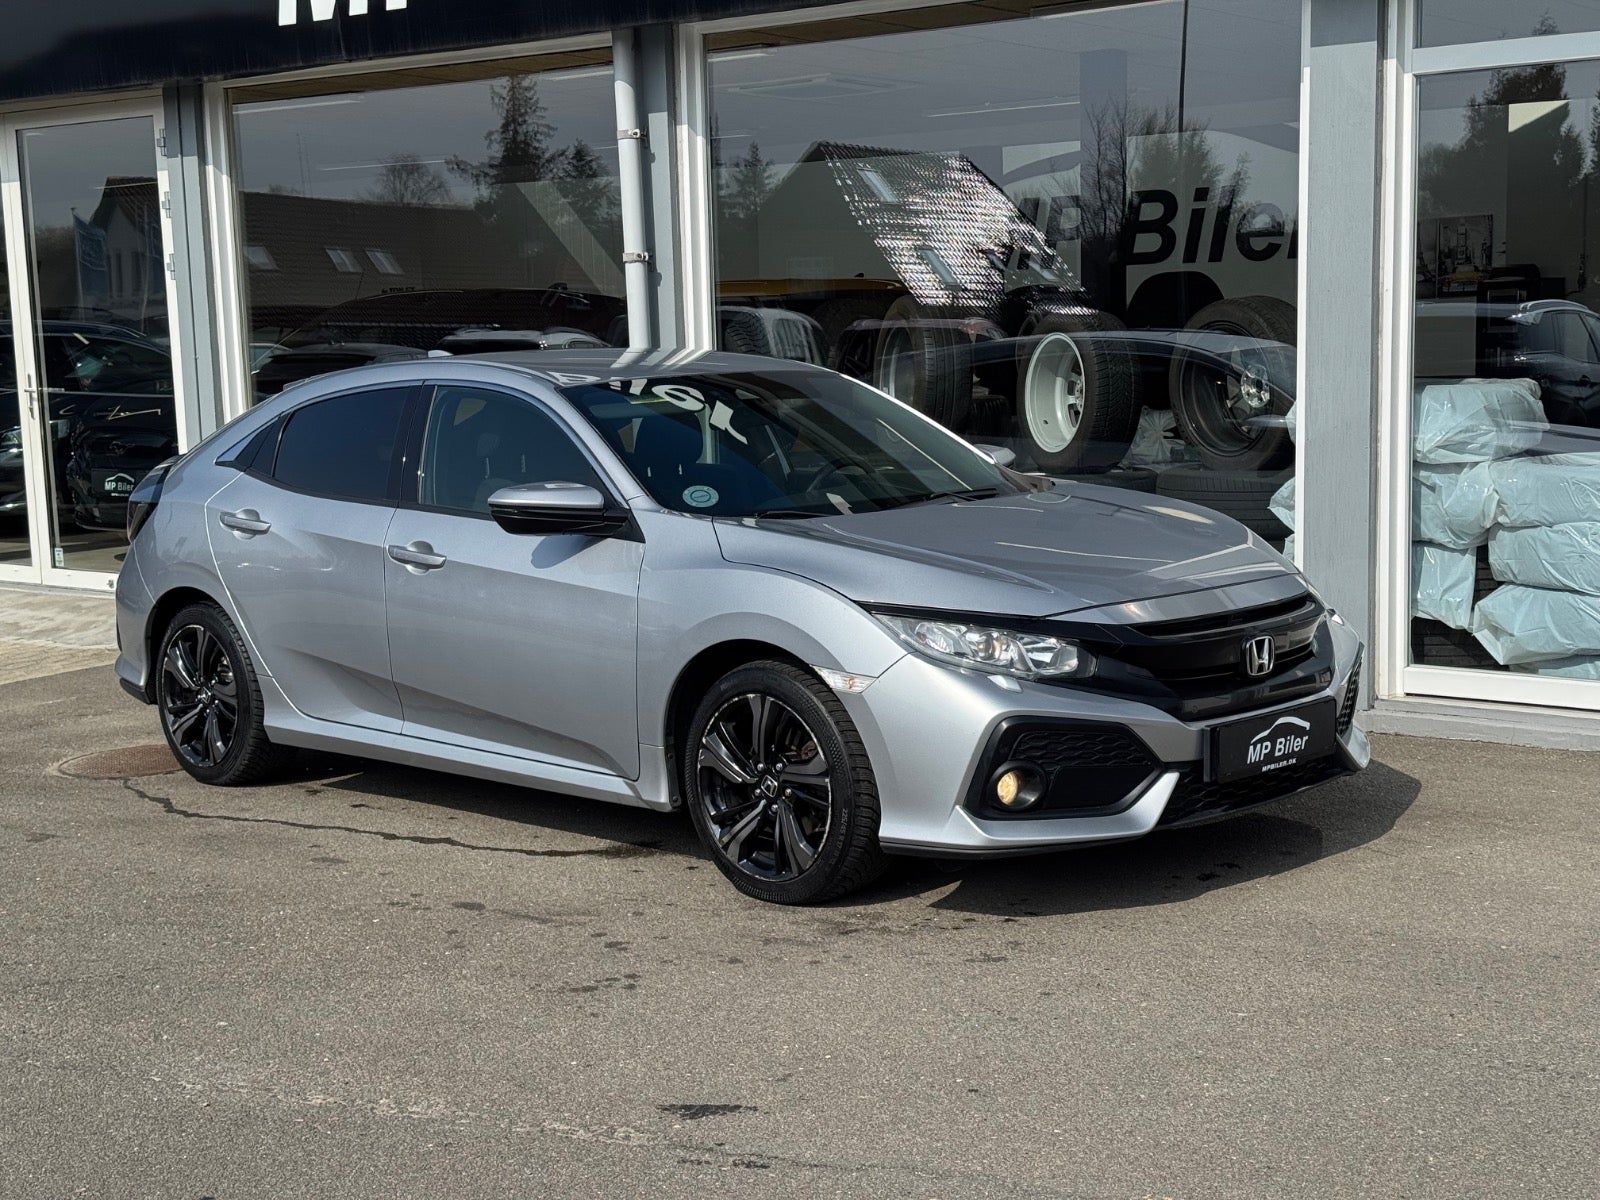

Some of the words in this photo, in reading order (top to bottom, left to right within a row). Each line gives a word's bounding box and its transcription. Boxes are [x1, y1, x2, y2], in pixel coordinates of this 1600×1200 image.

[1126, 185, 1298, 266] Bile
[104, 482, 117, 491] MP
[117, 482, 135, 491] Biler
[1246, 741, 1271, 764] MP
[1274, 735, 1309, 757] Biler
[1261, 758, 1297, 772] MPBILER.DK
